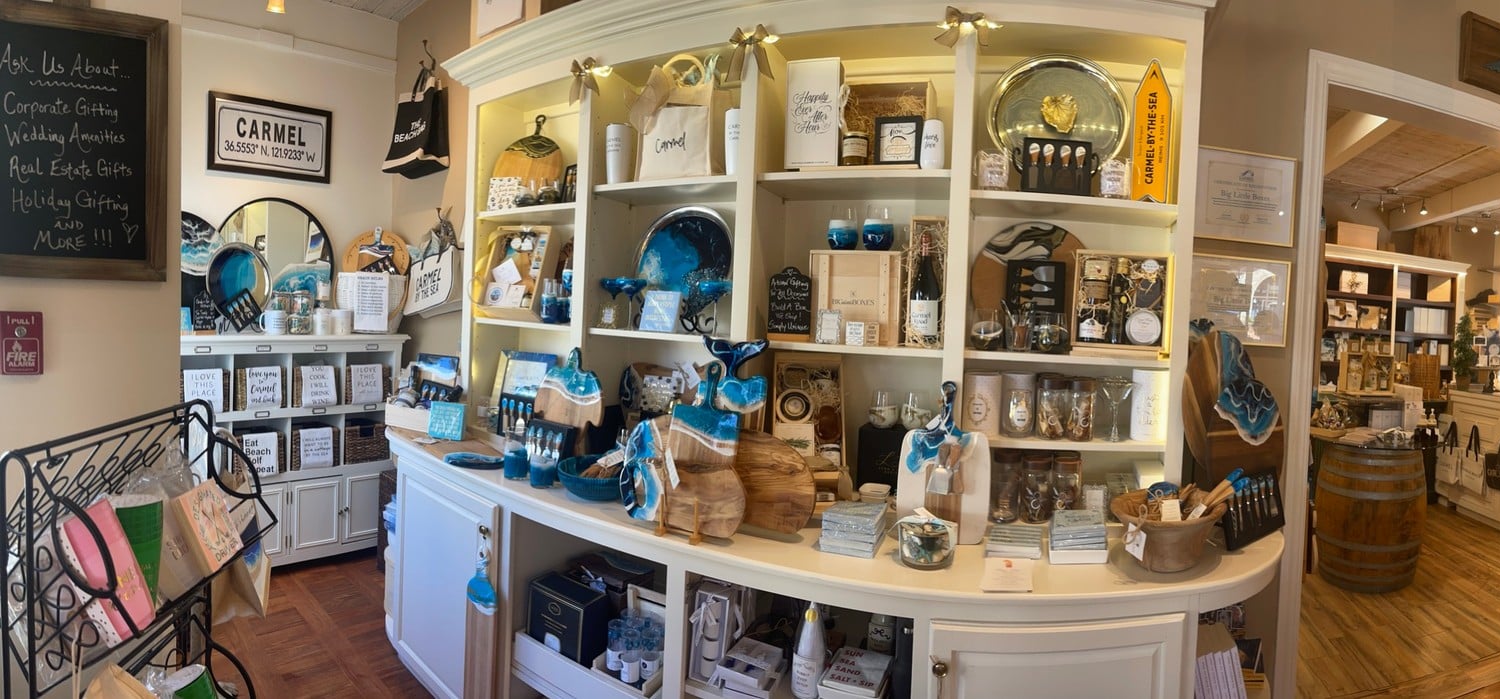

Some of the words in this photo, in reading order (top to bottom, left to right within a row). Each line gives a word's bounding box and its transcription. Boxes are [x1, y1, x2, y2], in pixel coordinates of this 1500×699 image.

[0, 42, 34, 75] Ask
[42, 50, 65, 75] Us
[4, 91, 71, 119] Corporate
[75, 97, 118, 123] Gifting
[4, 121, 65, 157] Wedding
[69, 122, 126, 153] Amenities
[236, 117, 306, 147] CARMEL
[224, 140, 259, 155] 36.5553°
[306, 151, 316, 162] W
[10, 155, 43, 184] Real
[50, 158, 93, 181] Estate
[97, 158, 133, 179] Gifts
[12, 187, 71, 219] Holiday
[75, 190, 129, 221] Gifting
[34, 230, 87, 252] MORE
[415, 268, 442, 292] CARMEL
[430, 283, 439, 296] SEA
[6, 351, 37, 362] FIRE
[244, 439, 259, 447] Eat
[244, 448, 271, 456] Beach
[840, 658, 856, 666] SEA
[844, 649, 864, 657] SUN
[829, 673, 851, 682] SALT
[858, 680, 874, 688] SIP
[834, 665, 861, 676] SAND
